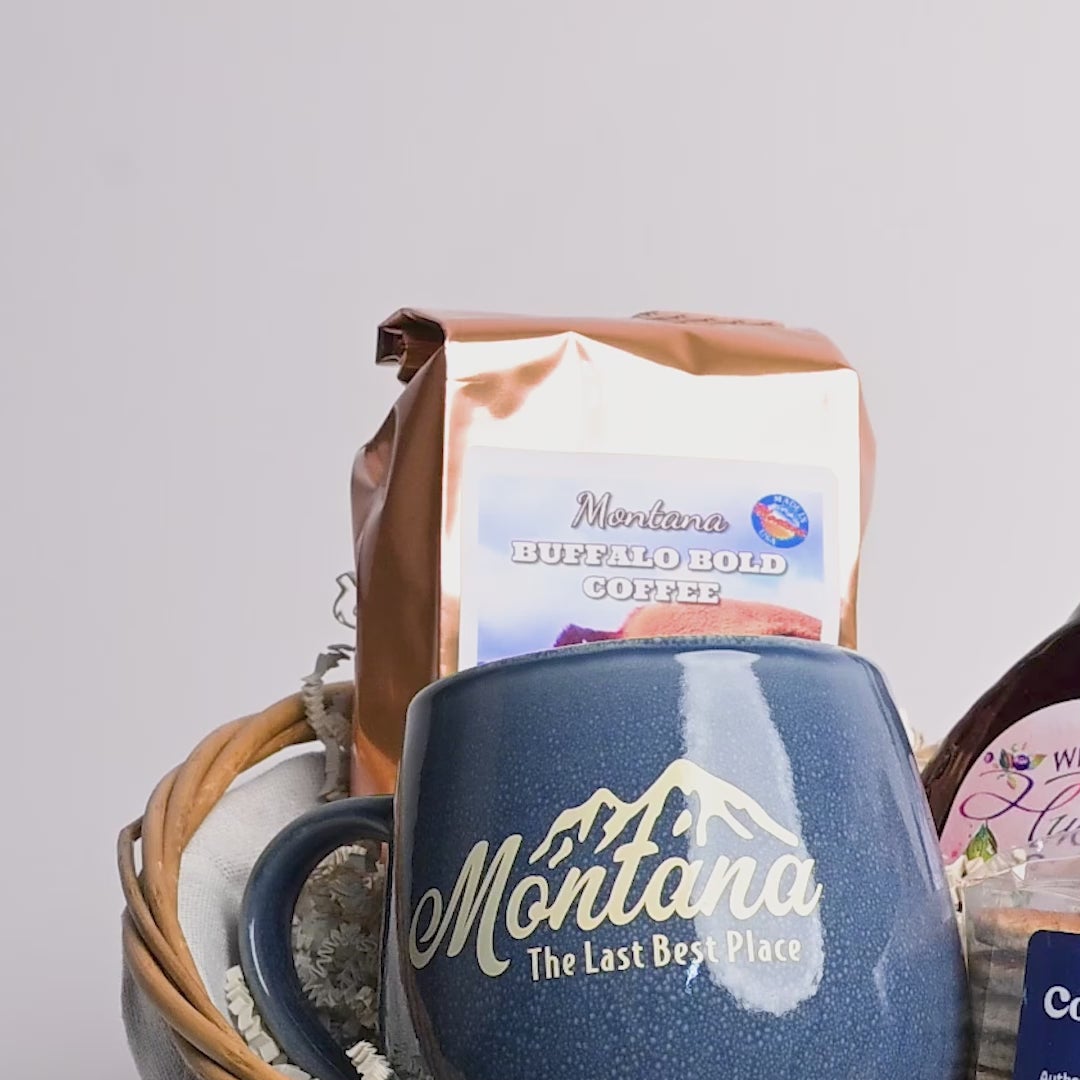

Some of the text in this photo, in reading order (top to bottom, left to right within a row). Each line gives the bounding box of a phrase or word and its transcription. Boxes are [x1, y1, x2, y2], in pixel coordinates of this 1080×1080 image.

[571, 490, 730, 533] Montana
[510, 540, 788, 575] BUFFALO BOLD
[582, 576, 722, 605] COFFEE
[409, 808, 824, 977] Montana
[527, 930, 801, 981] The Last Best Place
